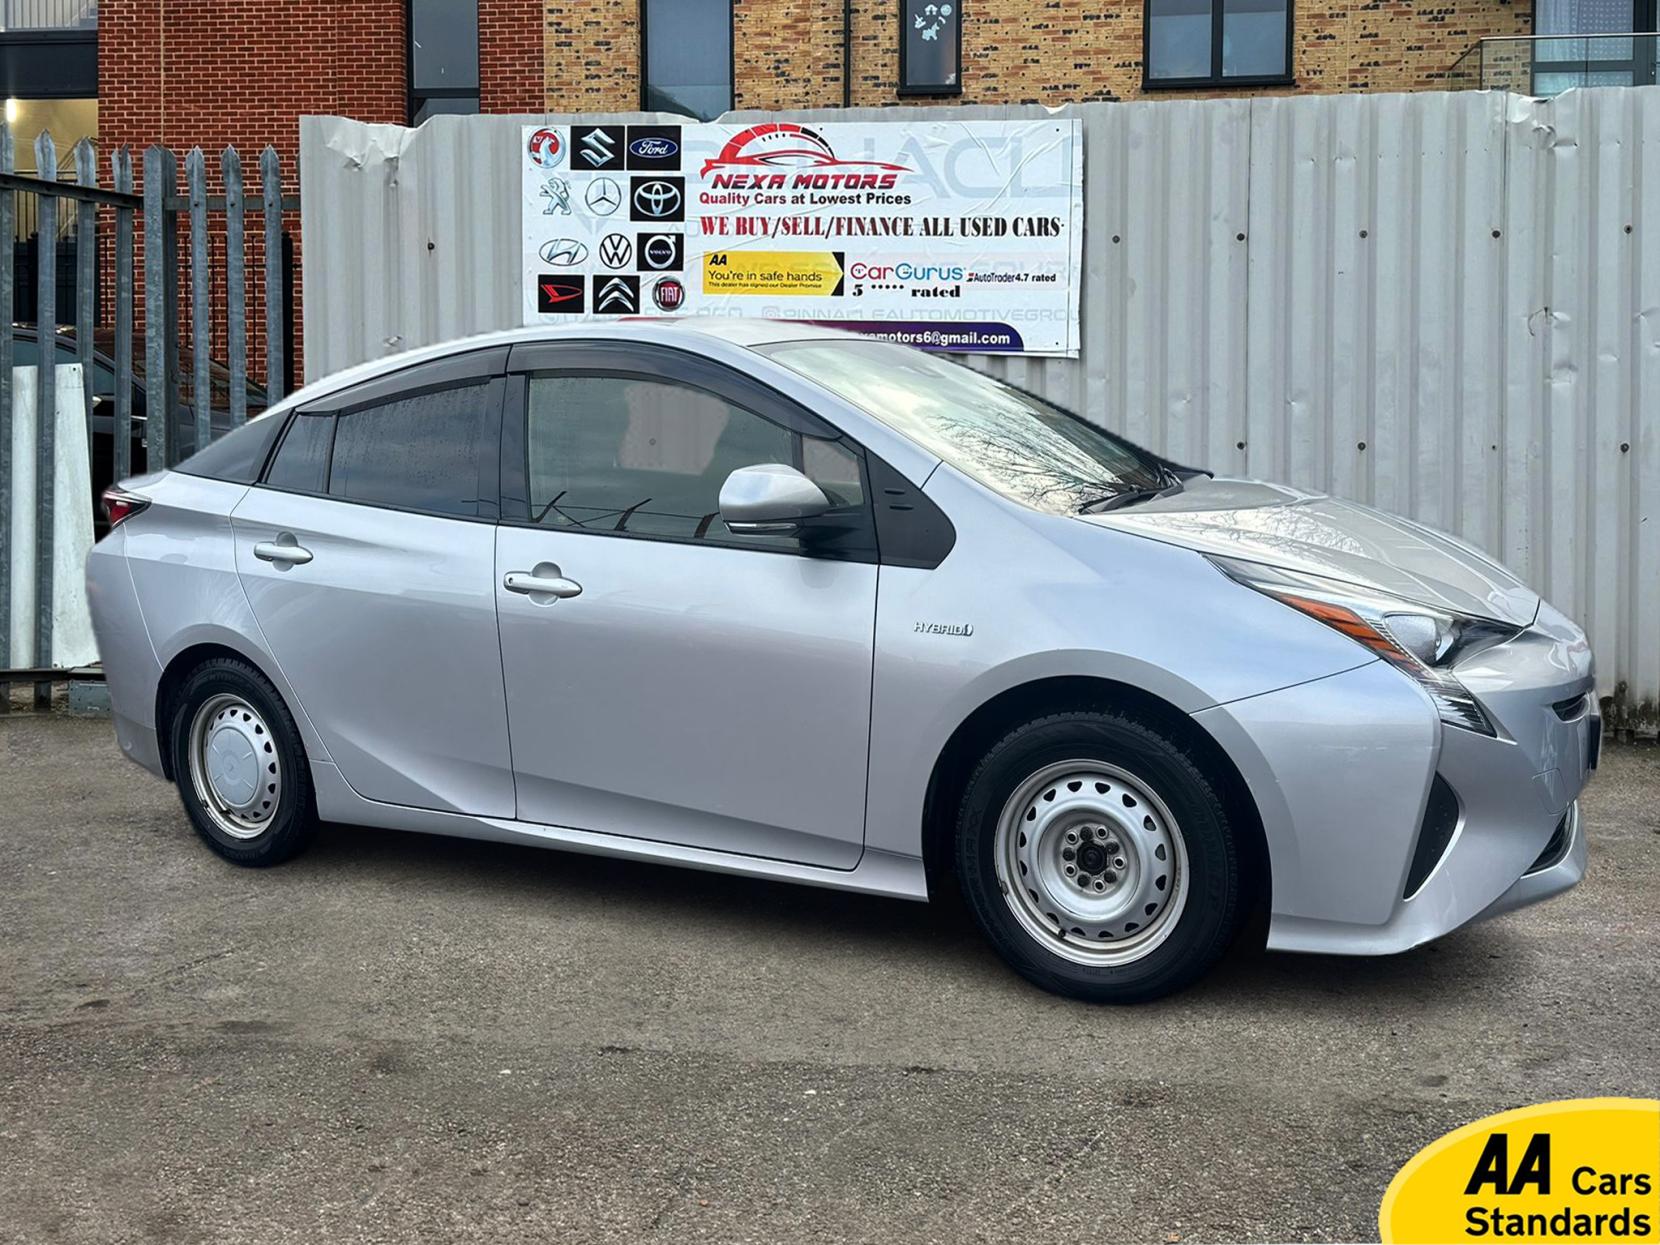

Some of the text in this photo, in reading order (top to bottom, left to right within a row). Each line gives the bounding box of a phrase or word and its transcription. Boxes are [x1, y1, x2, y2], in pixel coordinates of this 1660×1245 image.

[639, 141, 668, 155] Ford
[711, 174, 897, 190] NEXA MOTORS
[699, 192, 912, 207] Quality Cars at Lowest Prices
[700, 216, 729, 236] WE
[919, 216, 954, 237] ALL
[960, 216, 1007, 238] USED
[1012, 216, 1060, 238] CARS
[709, 254, 727, 266] AA
[708, 269, 823, 282] You're in safe hands
[850, 262, 963, 281] CarGurus
[1031, 273, 1056, 282] rated
[660, 286, 679, 303] FIAT
[852, 284, 961, 298] 5 rated
[914, 621, 974, 637] HYBRID
